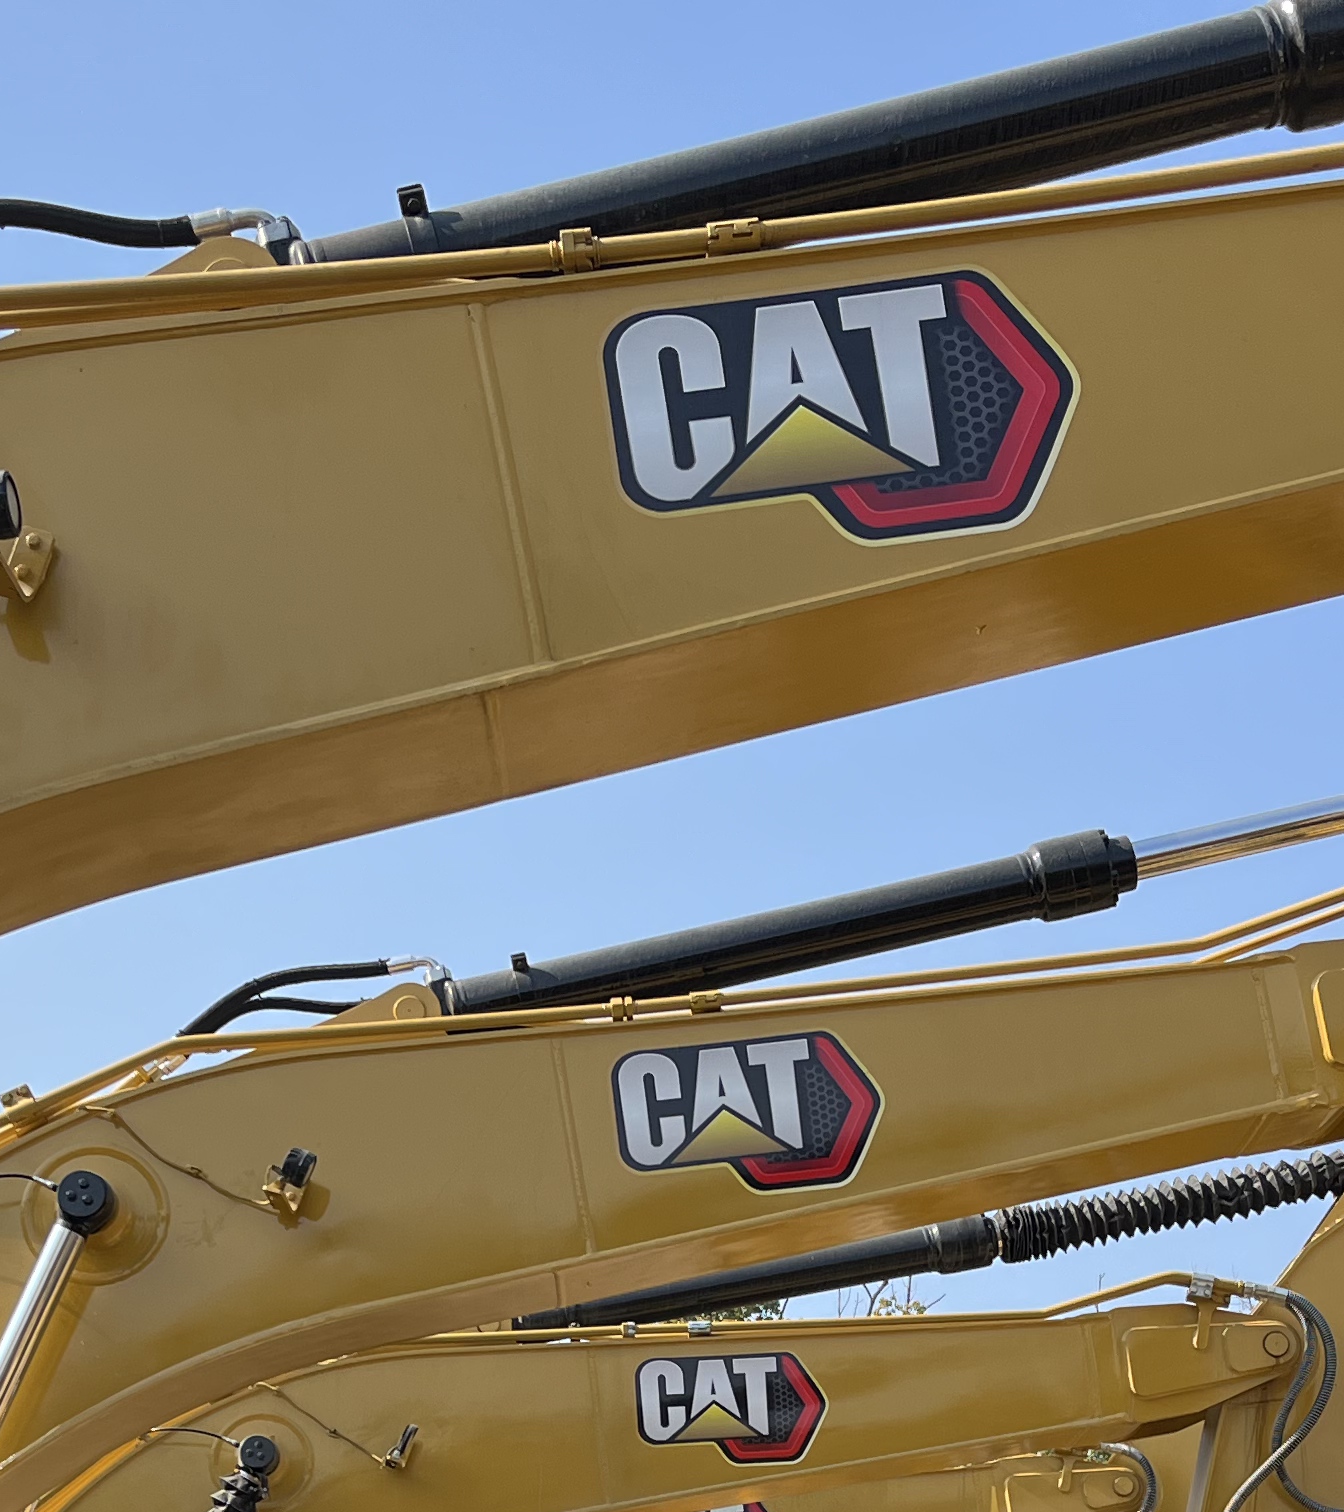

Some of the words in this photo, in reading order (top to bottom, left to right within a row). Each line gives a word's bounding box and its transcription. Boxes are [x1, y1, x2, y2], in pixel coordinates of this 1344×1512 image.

[615, 284, 947, 502] CAT
[618, 1038, 810, 1166] CAT
[640, 1357, 777, 1441] CAT
